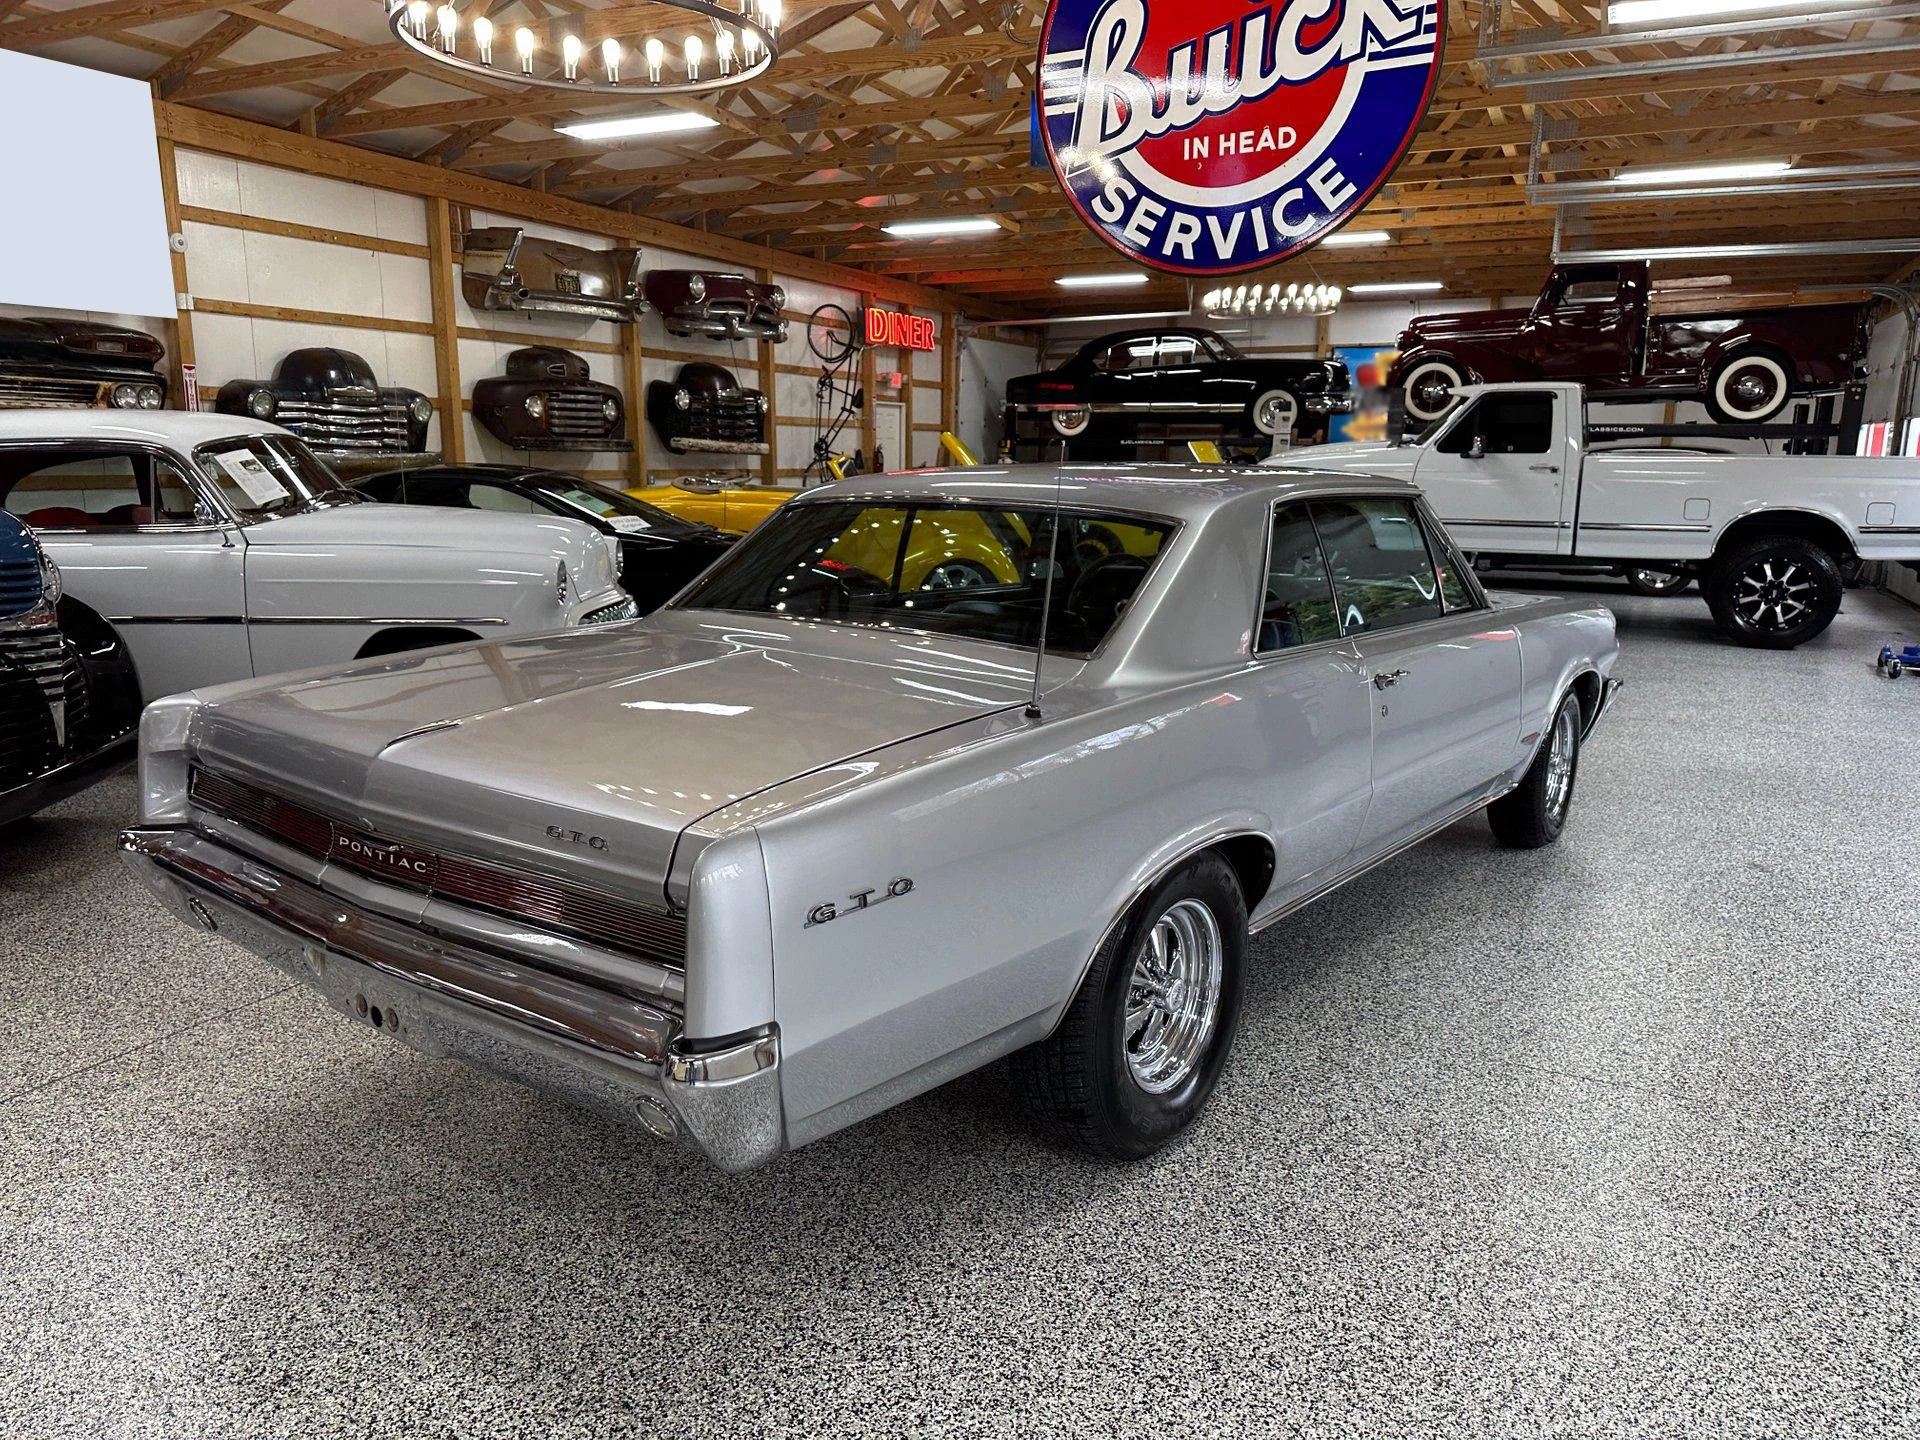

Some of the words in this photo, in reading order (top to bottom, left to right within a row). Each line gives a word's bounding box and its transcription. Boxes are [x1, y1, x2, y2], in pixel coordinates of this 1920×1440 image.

[1072, 0, 1421, 167] Buick
[1183, 137, 1209, 161] IN
[1219, 126, 1298, 157] HEAD
[1091, 157, 1358, 260] SERVICE
[866, 307, 936, 350] DINER
[339, 836, 427, 873] PONTIAC
[545, 824, 609, 851] GTO
[804, 877, 916, 929] GTO
